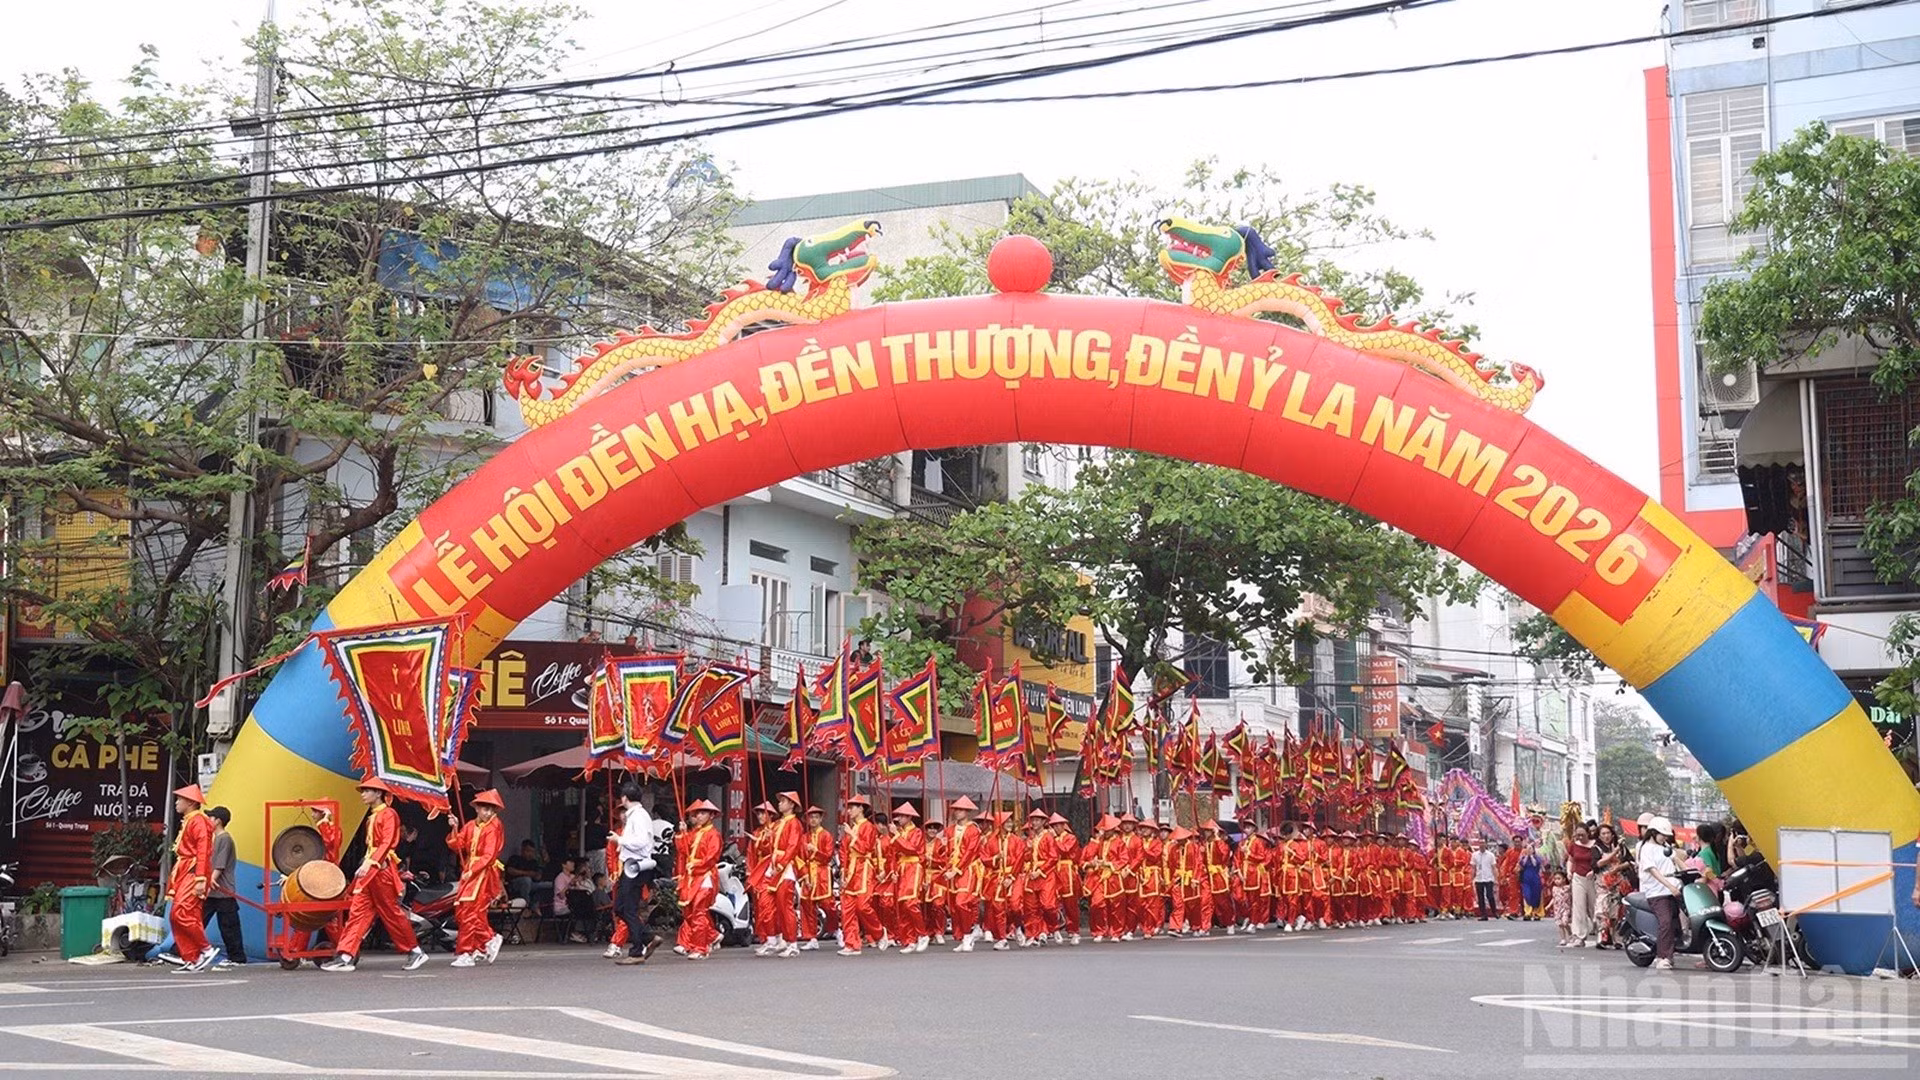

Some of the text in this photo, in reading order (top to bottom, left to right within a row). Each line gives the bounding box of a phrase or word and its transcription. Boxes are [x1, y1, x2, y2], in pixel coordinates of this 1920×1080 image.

[412, 529, 495, 616] LỄ
[470, 478, 573, 574] HỘI
[556, 422, 680, 511] ĐỀN
[758, 338, 879, 416] ĐỀN
[1124, 325, 1246, 404] ĐỀN
[1248, 345, 1288, 412] Ỷ
[1281, 370, 1357, 439] LA
[1359, 395, 1509, 498] NĂM
[1493, 464, 1648, 586] 2026
[531, 661, 582, 699] Coffee
[51, 738, 160, 771] CÀ PHÊ
[14, 784, 83, 820] Coffee
[128, 782, 149, 797] ĐÁ
